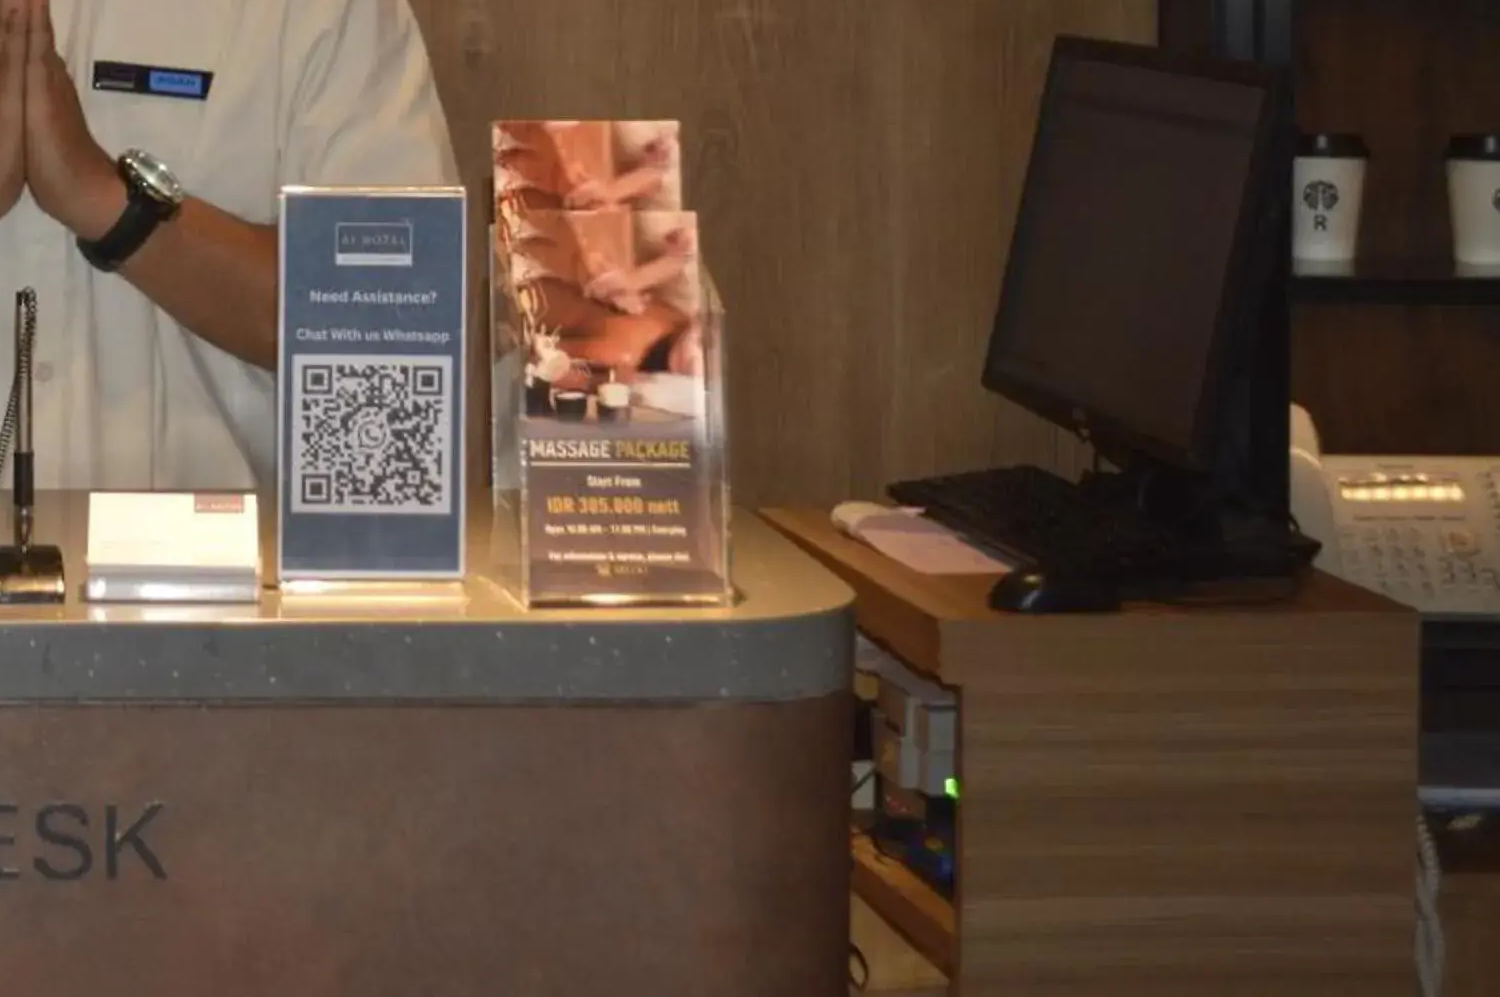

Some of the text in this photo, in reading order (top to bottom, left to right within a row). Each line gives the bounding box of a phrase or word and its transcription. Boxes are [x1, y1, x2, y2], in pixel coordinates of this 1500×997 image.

[1313, 214, 1328, 232] R
[309, 290, 438, 304] Need Assistance?
[296, 327, 451, 346] Chat With us Whatsapp
[529, 439, 691, 460] MASSAGE PACKAGE
[586, 474, 642, 488] Start From
[546, 496, 574, 514] IDR
